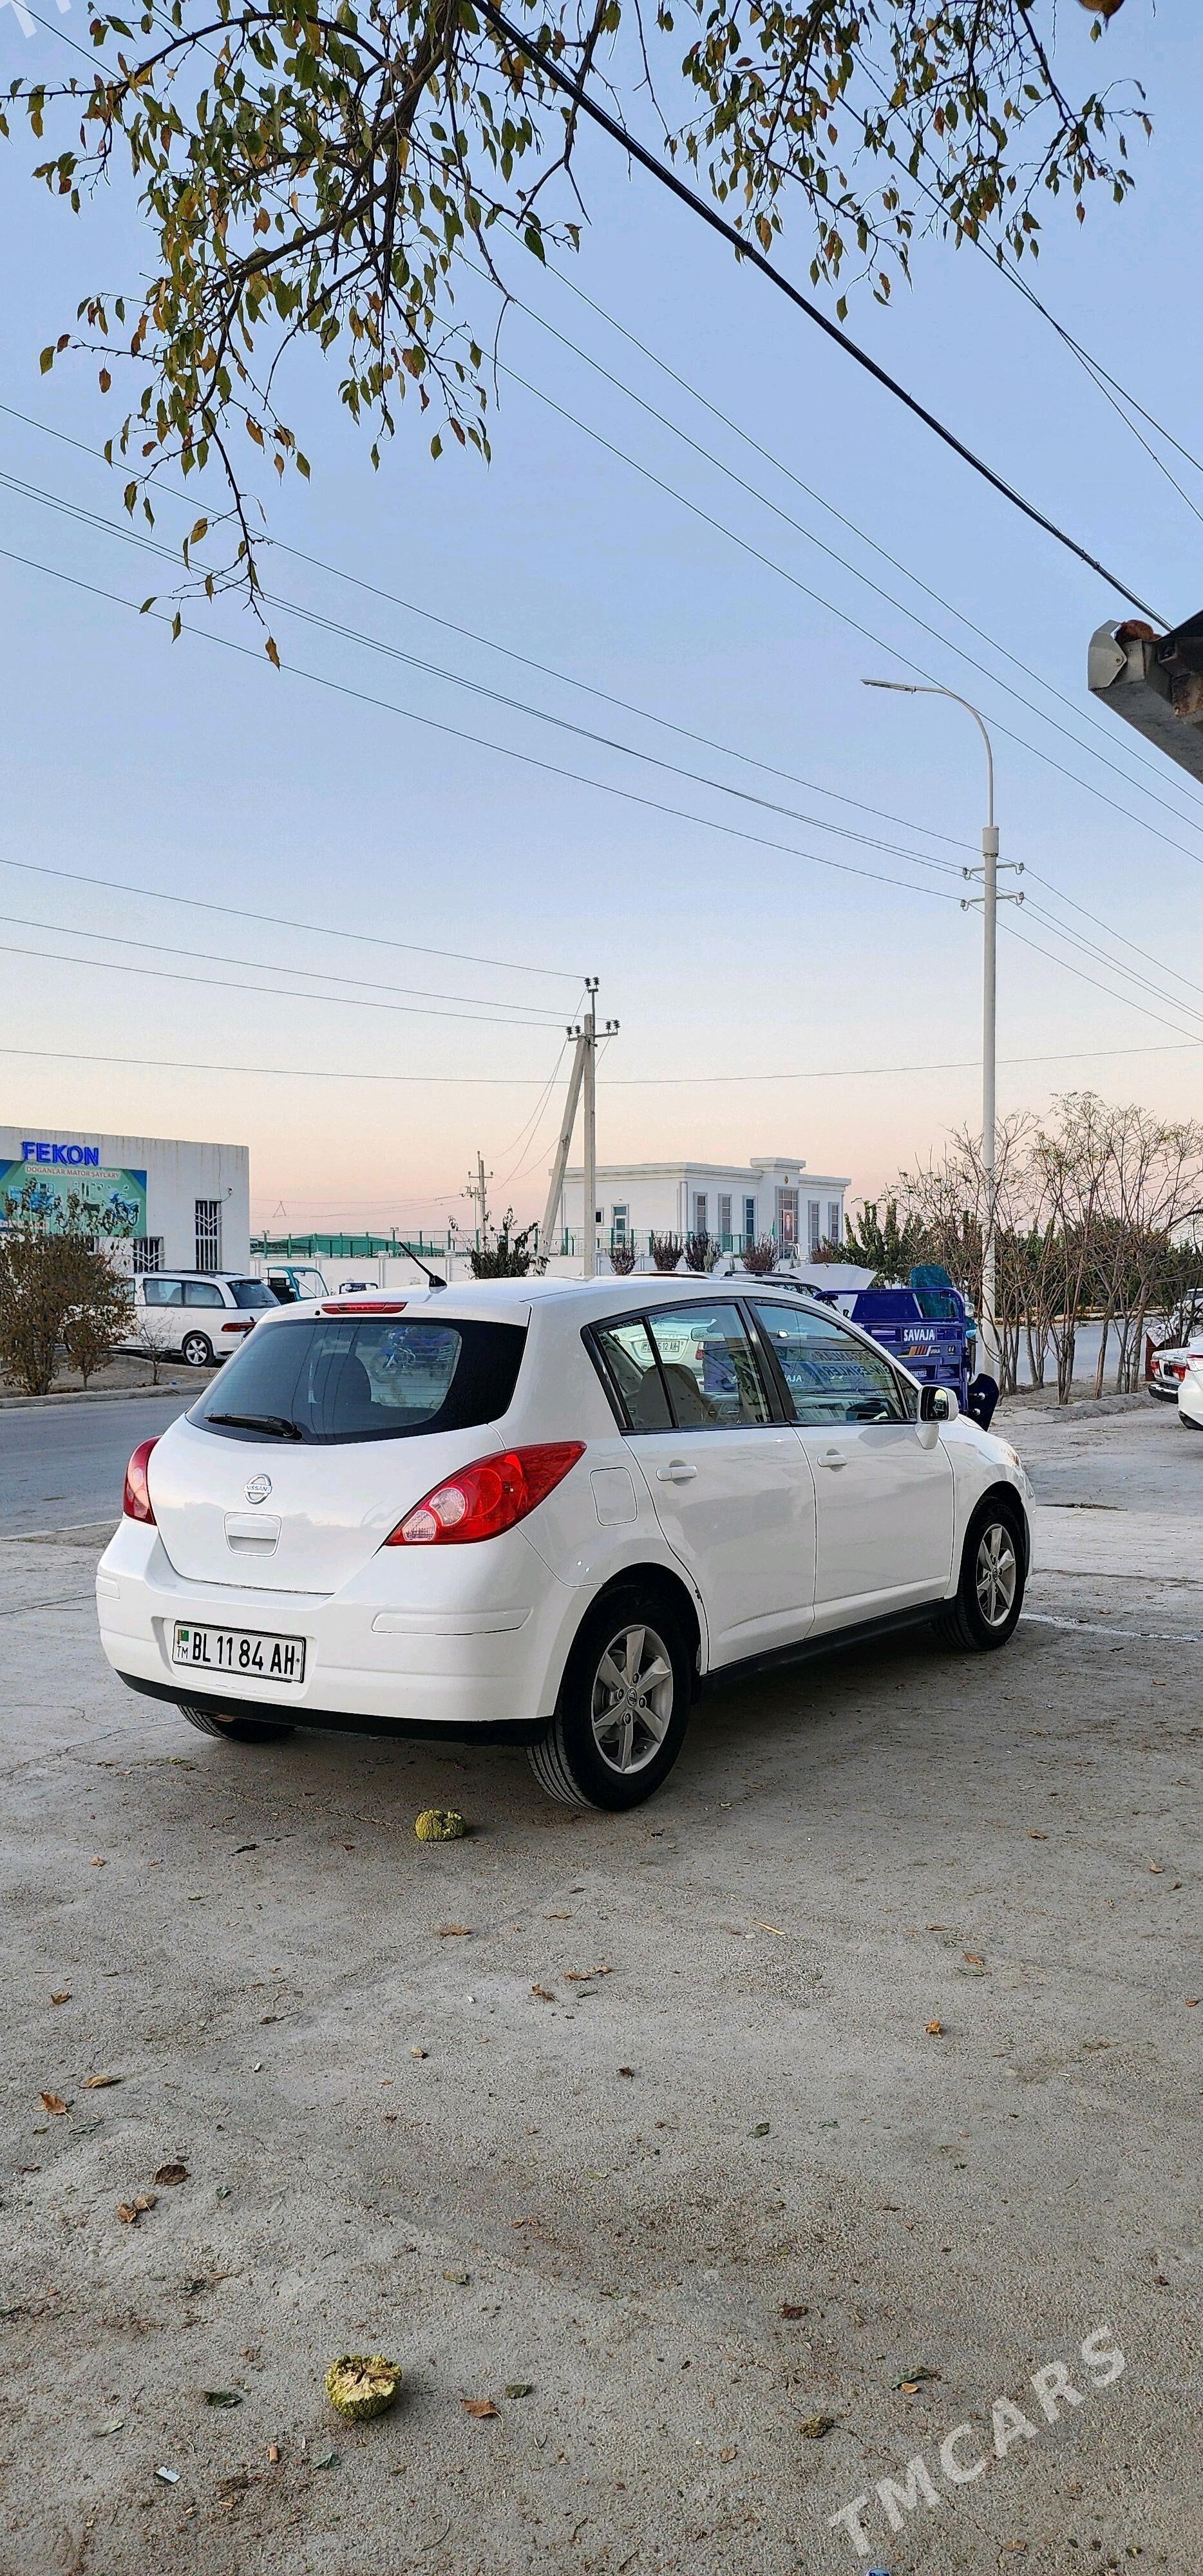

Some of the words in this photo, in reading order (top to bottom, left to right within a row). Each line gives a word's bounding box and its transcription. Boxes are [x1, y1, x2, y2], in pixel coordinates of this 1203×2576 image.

[22, 1141, 99, 1166] FEKON
[26, 1166, 66, 1175] DOGANLAR
[904, 1329, 936, 1341] SAVAJA
[177, 1645, 188, 1659] TM
[193, 1631, 211, 1663] BL
[217, 1635, 233, 1666] 11
[239, 1638, 263, 1671] 84
[270, 1643, 295, 1676] AH
